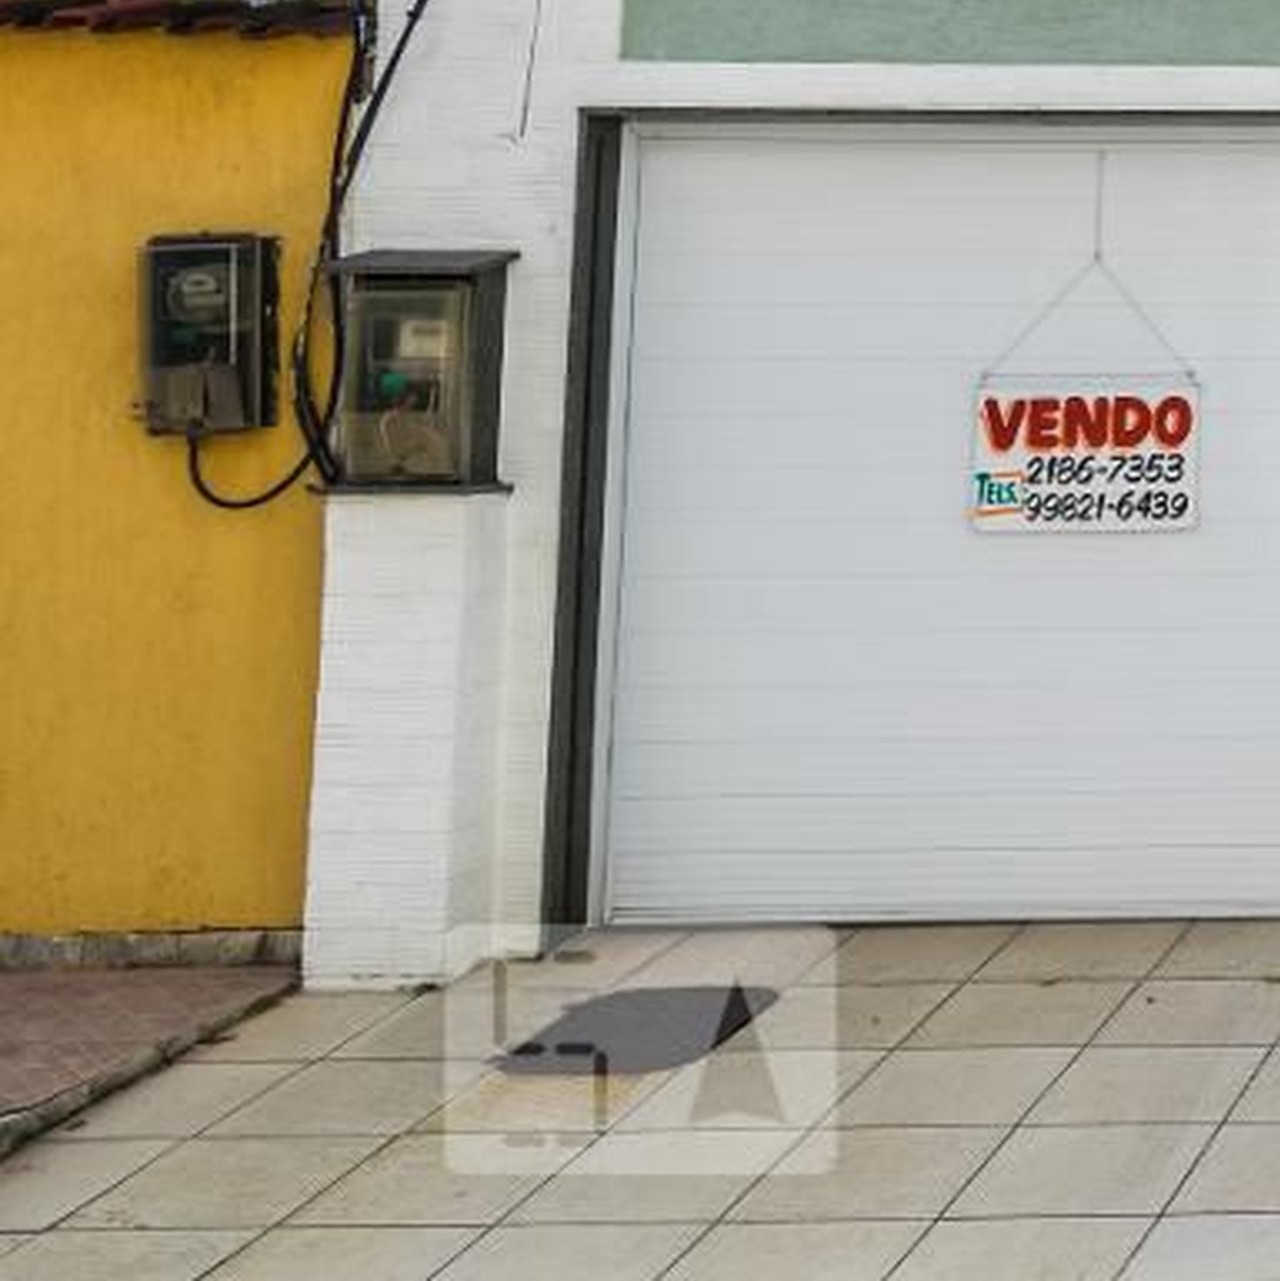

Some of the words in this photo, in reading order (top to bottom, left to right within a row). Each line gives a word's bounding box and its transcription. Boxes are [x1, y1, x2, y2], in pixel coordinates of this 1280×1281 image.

[982, 396, 1193, 450] VENDO
[1027, 454, 1185, 485] 2186-7353
[1023, 490, 1189, 521] 99821-6439
